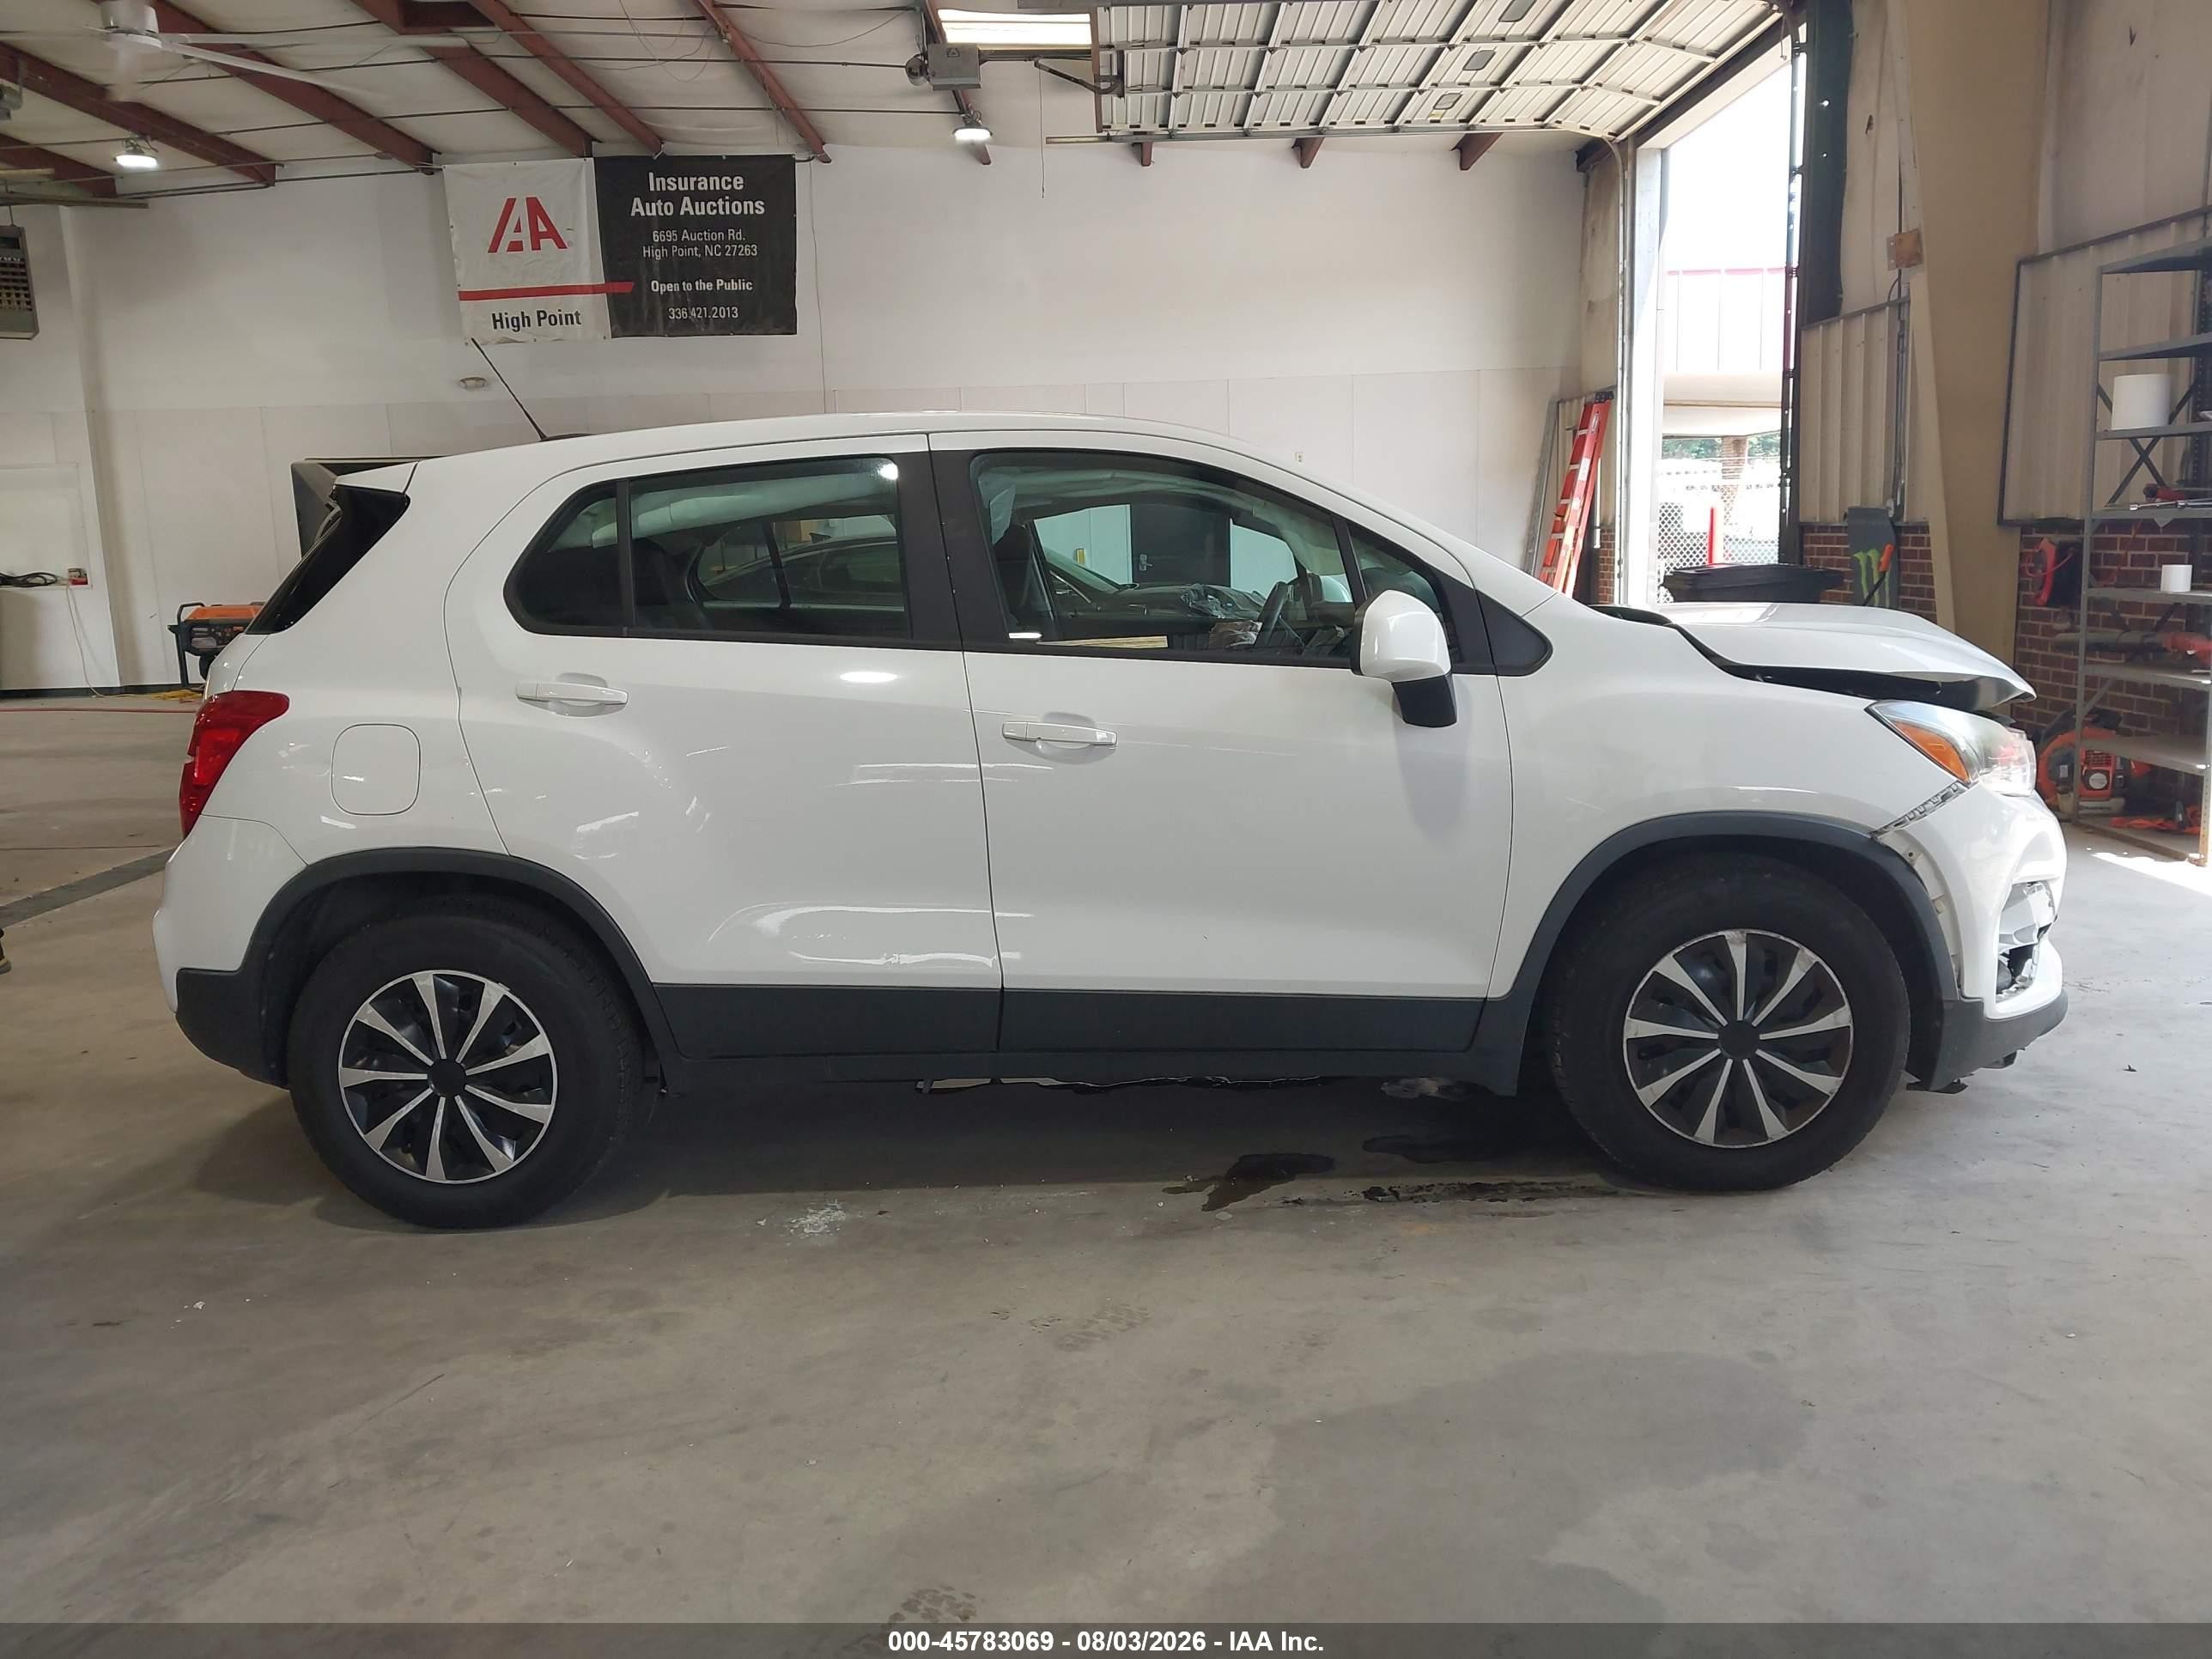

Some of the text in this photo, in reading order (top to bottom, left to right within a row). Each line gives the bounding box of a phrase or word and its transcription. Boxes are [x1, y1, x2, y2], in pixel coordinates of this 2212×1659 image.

[648, 172, 744, 191] Insurance
[630, 196, 765, 216] Auto Auctions
[652, 228, 746, 242] 6695 Auction Rd.
[642, 244, 757, 261] High Point, NC 27263
[651, 278, 753, 295] Open to the Public
[491, 308, 582, 333] High Point
[668, 306, 738, 319] 336.421.2013
